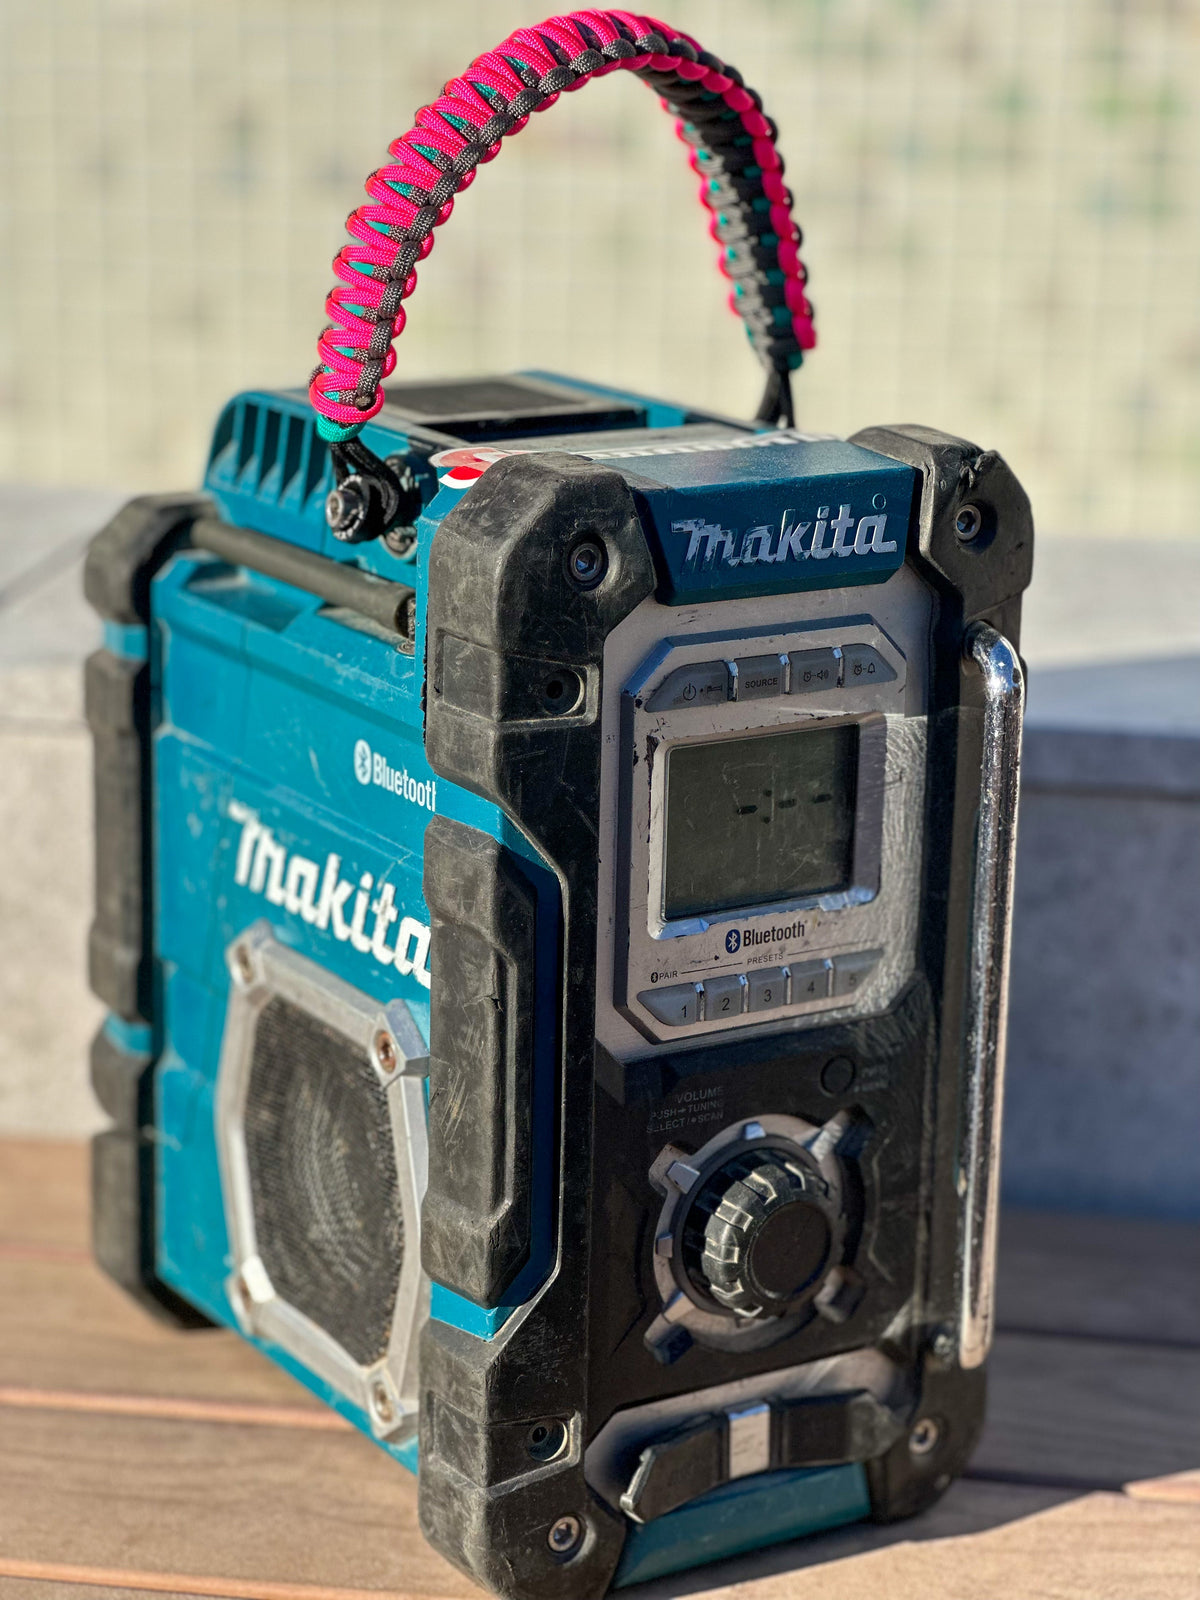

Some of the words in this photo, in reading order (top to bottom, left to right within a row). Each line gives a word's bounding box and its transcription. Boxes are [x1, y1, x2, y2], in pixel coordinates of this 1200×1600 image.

[745, 677, 778, 689] SOURCE
[743, 921, 805, 948] Bluetooth
[746, 952, 784, 966] PRESETS
[658, 970, 679, 980] PAIR
[681, 1004, 688, 1018] 1
[721, 997, 731, 1011] 2
[763, 989, 773, 1002] 3
[807, 980, 816, 994] 4
[677, 1086, 724, 1104] VOLUME
